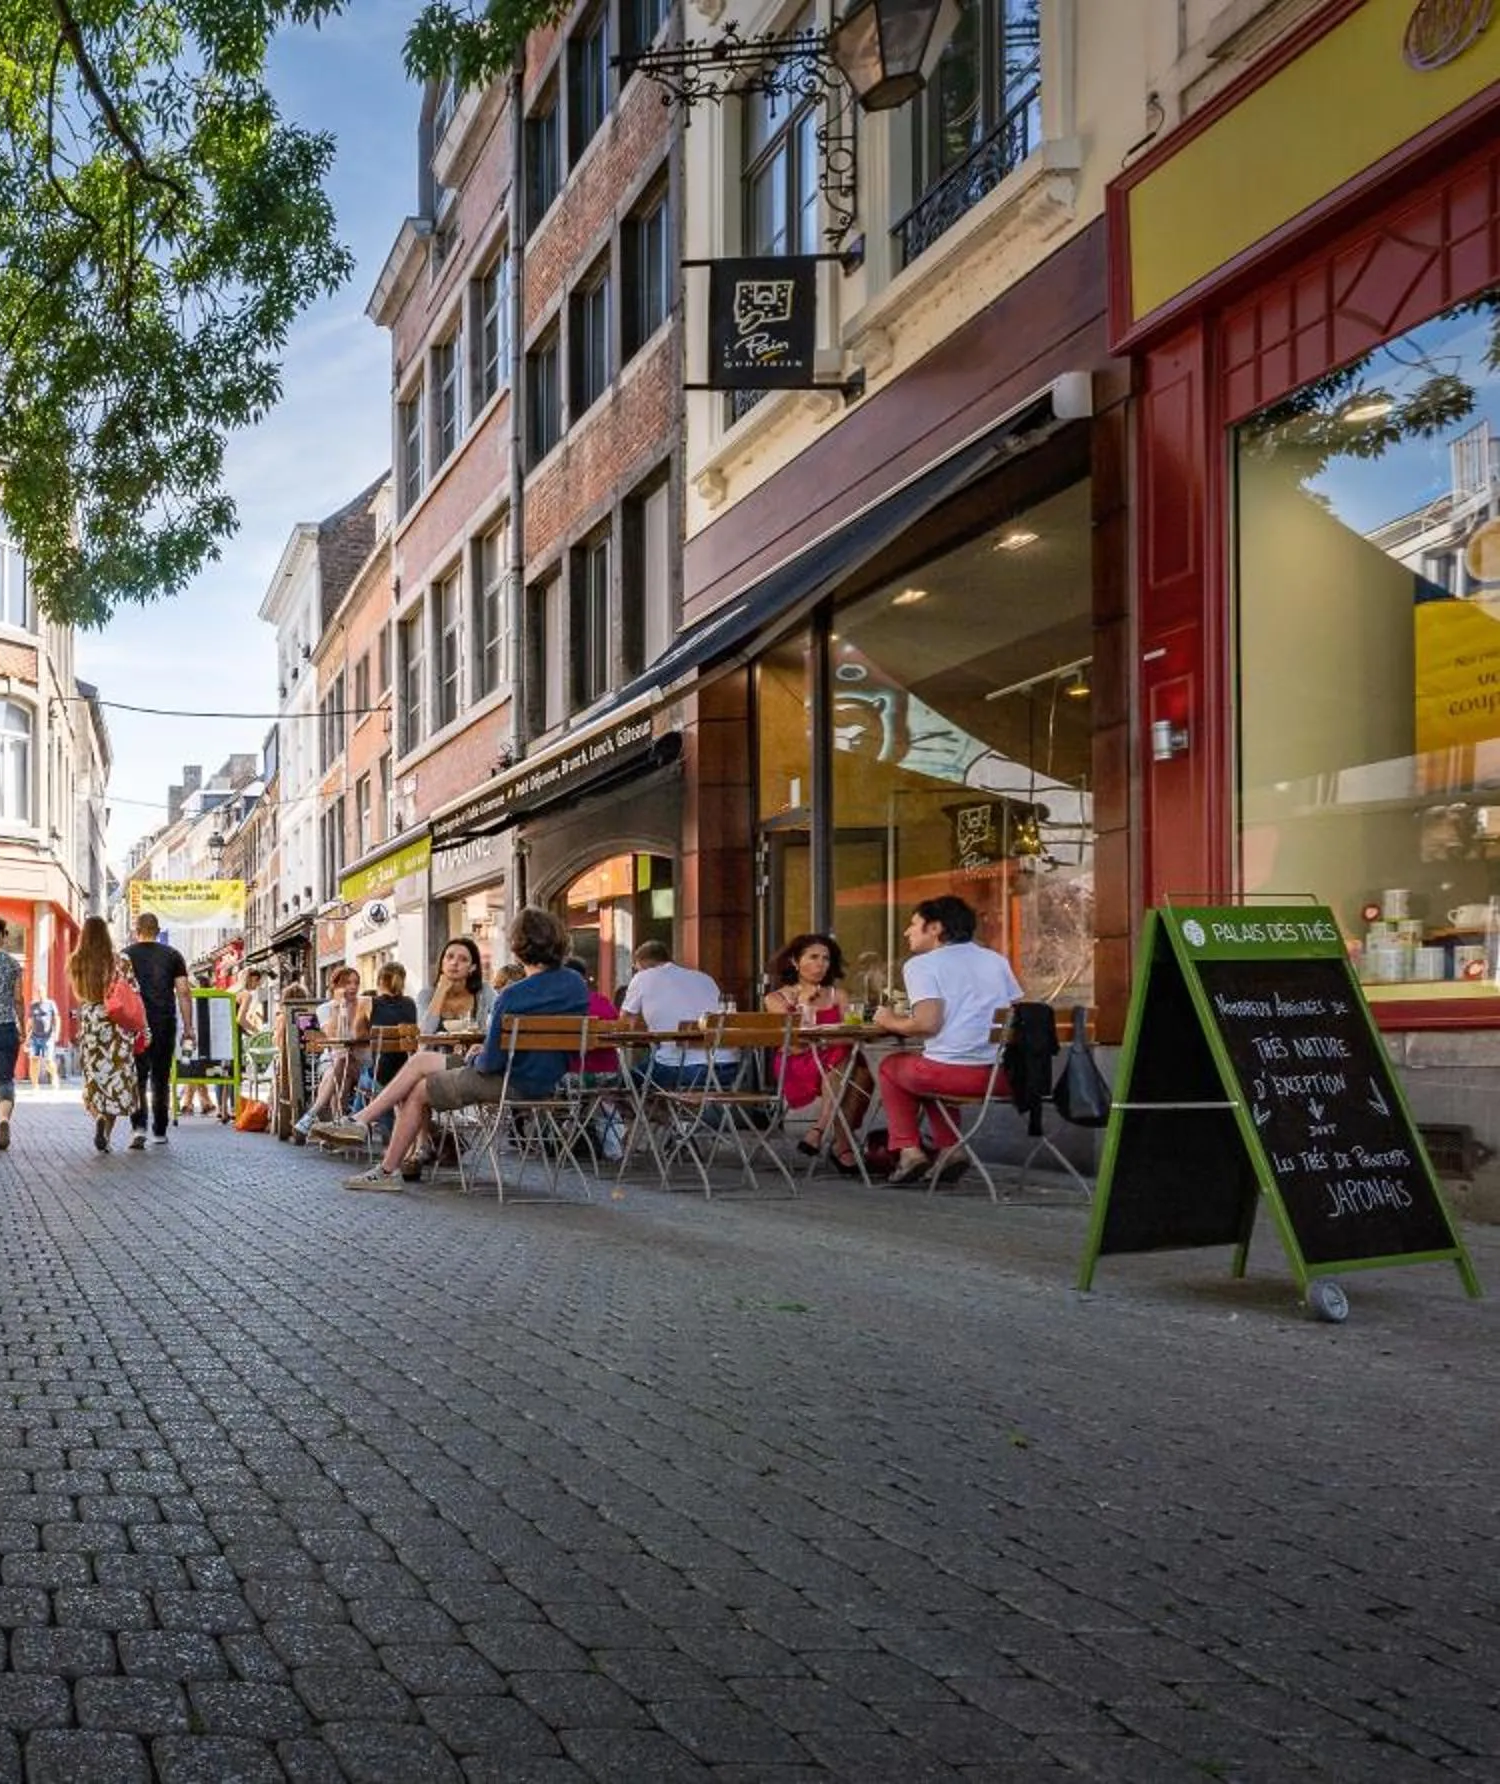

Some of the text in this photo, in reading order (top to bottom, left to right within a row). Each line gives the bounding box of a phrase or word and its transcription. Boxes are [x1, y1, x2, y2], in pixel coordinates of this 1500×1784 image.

[733, 332, 789, 359] Pain
[1211, 919, 1337, 942] PALAIS DES THÉS
[1293, 1036, 1352, 1059] NATURE
